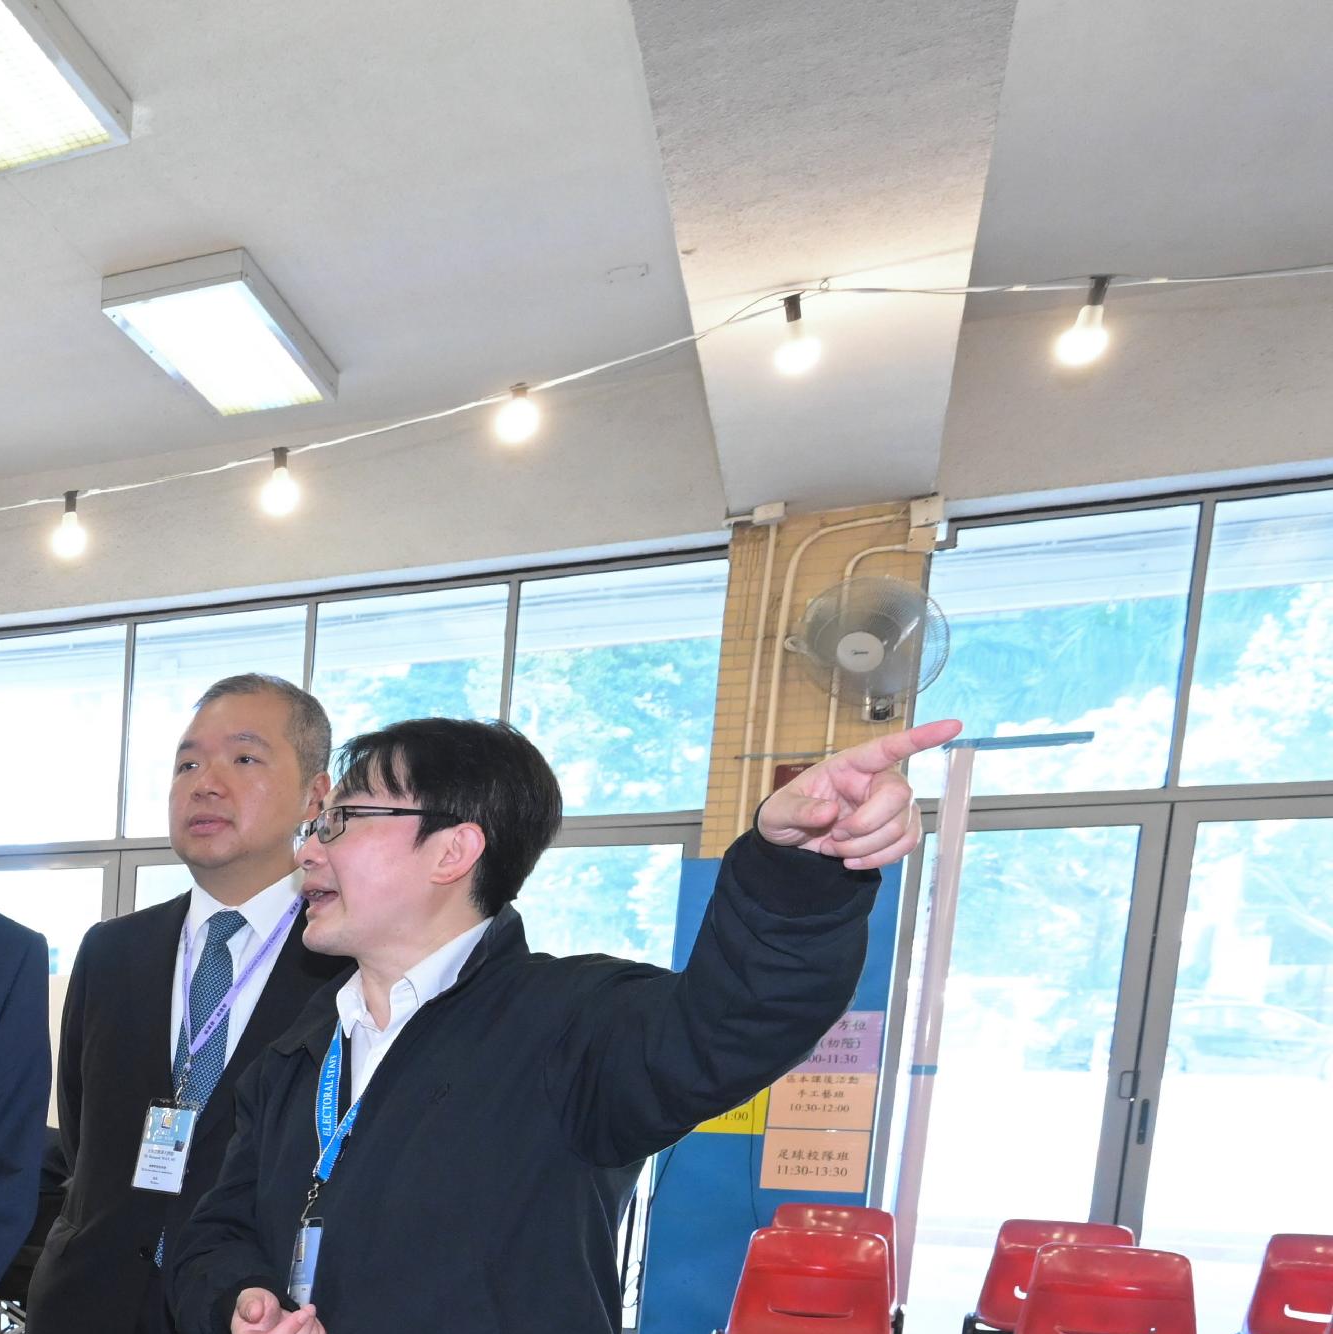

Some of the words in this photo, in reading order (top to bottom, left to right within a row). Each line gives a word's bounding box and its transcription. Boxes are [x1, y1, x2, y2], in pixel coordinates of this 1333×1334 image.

[326, 1054, 338, 1079] STAFF
[322, 1079, 334, 1137] ELECTORAL
[789, 1103, 850, 1113] 10:30-12:00
[777, 1148, 850, 1161] 足球校隊班
[776, 1164, 848, 1177] 11:30-13:30
